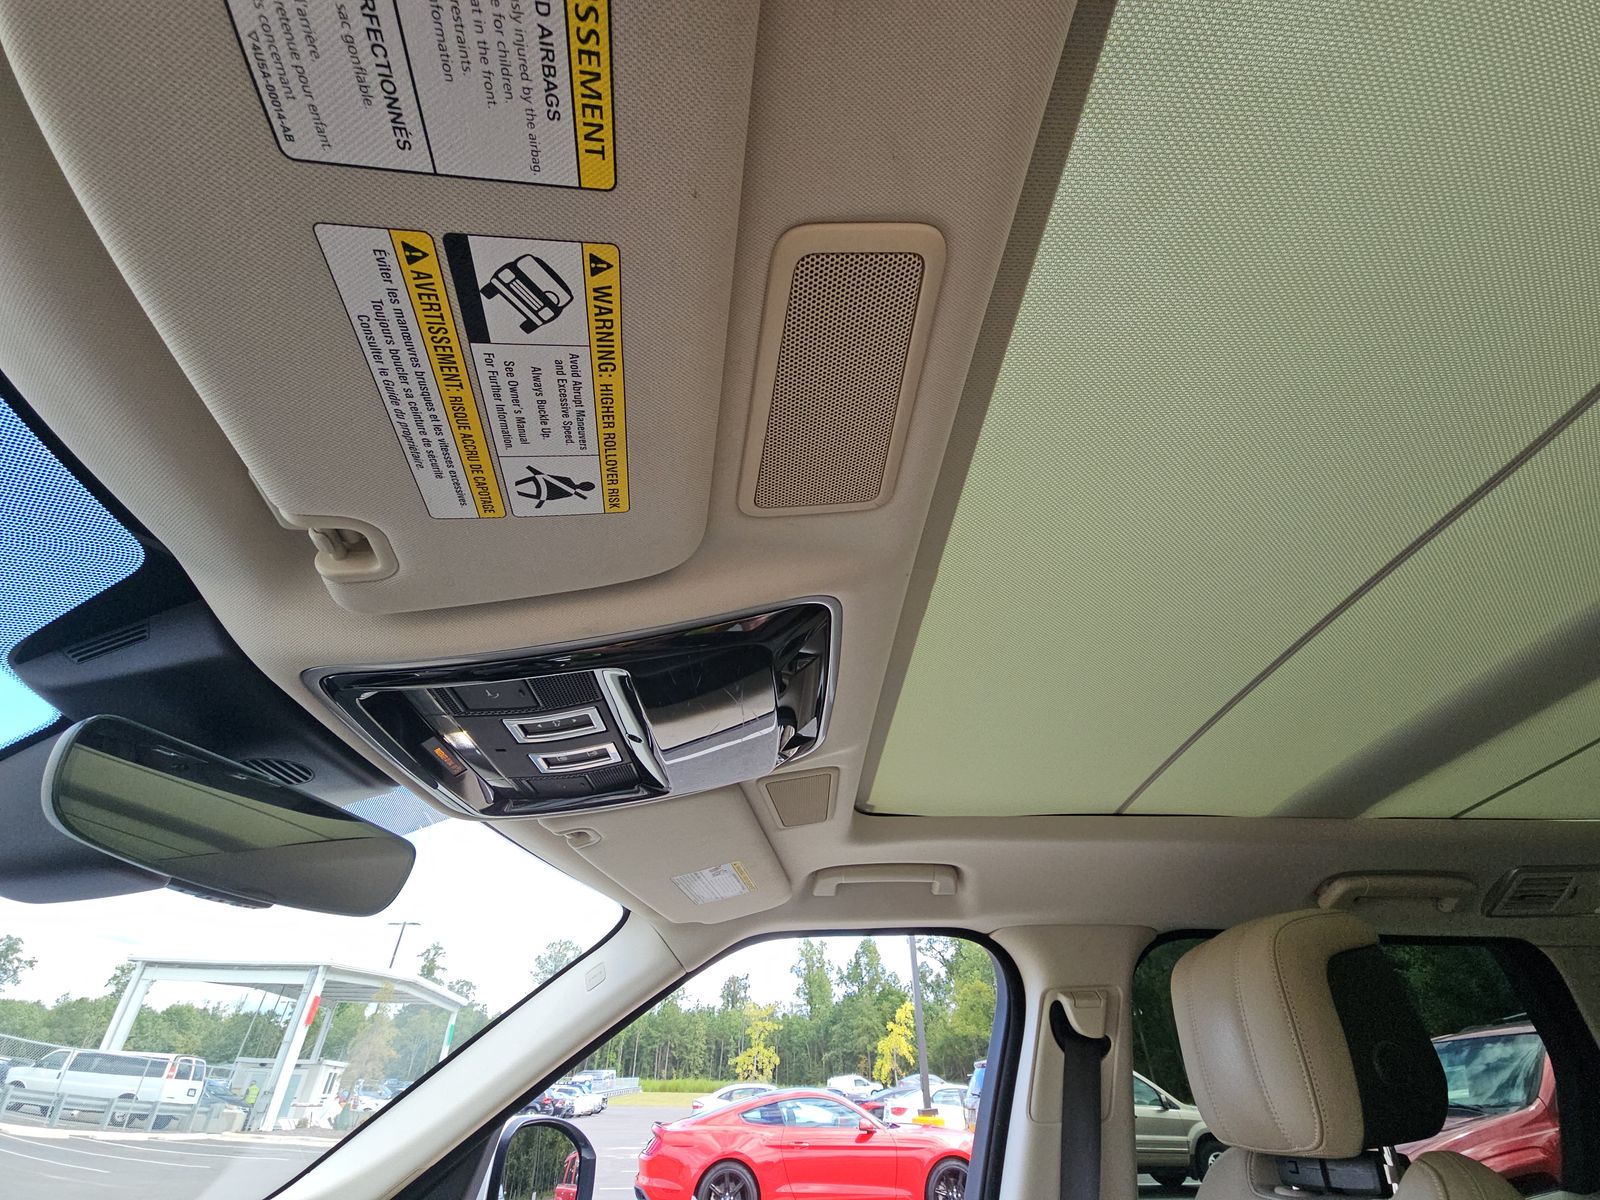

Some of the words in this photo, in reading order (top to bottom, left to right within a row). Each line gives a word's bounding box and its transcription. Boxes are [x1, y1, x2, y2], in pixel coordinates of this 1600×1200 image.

[335, 3, 351, 30] sac
[474, 20, 487, 34] in
[493, 13, 505, 36] for
[259, 14, 296, 100] concernant
[477, 40, 490, 65] the
[513, 28, 533, 82] injured
[274, 0, 301, 60] retenue
[292, 64, 315, 101] pour
[308, 103, 332, 150] enfant.
[341, 34, 374, 109] gonflable.
[496, 41, 514, 104] children.
[537, 23, 561, 121] AIRBAGS
[575, 0, 605, 161] SSEMENT
[482, 69, 498, 109] front.
[520, 86, 533, 105] by
[525, 108, 537, 129] the
[528, 133, 541, 176] airbag.
[373, 249, 393, 284] Éviter
[386, 288, 400, 305] les
[370, 299, 395, 345] Toujours
[410, 270, 464, 391] AVERTISSEMENT:
[592, 285, 617, 377] WARNING:
[357, 314, 384, 364] Consulter
[378, 367, 389, 377] le
[389, 348, 410, 385] boucler
[483, 353, 495, 367] For
[503, 360, 515, 377] See
[554, 360, 566, 376] and
[569, 353, 581, 378] Avoid
[383, 379, 400, 406] Guide
[403, 387, 414, 399] sa
[414, 371, 436, 412] brusques
[488, 370, 502, 401] Further
[531, 366, 543, 397] Always
[572, 380, 584, 407] Abrupt
[508, 381, 523, 414] Owner's
[557, 378, 571, 418] Excessive
[600, 384, 615, 428] HIGHER
[394, 408, 406, 420] du
[408, 401, 427, 436] ceinture
[429, 414, 441, 423] et
[448, 396, 472, 431] RISQUE
[496, 404, 513, 450] Information.
[537, 400, 549, 426] Buckle
[421, 437, 433, 447] de
[433, 424, 444, 436] les
[515, 416, 530, 445] Manual
[540, 428, 551, 440] Up.
[563, 421, 575, 445] Speed.
[576, 410, 587, 451] Maneuvers
[438, 438, 455, 468] vitesses
[460, 433, 479, 463] ACCRU
[603, 433, 618, 486] ROLLOVER
[469, 464, 484, 475] DE
[473, 475, 495, 513] CAPOTAGE
[607, 488, 620, 509] RISK
